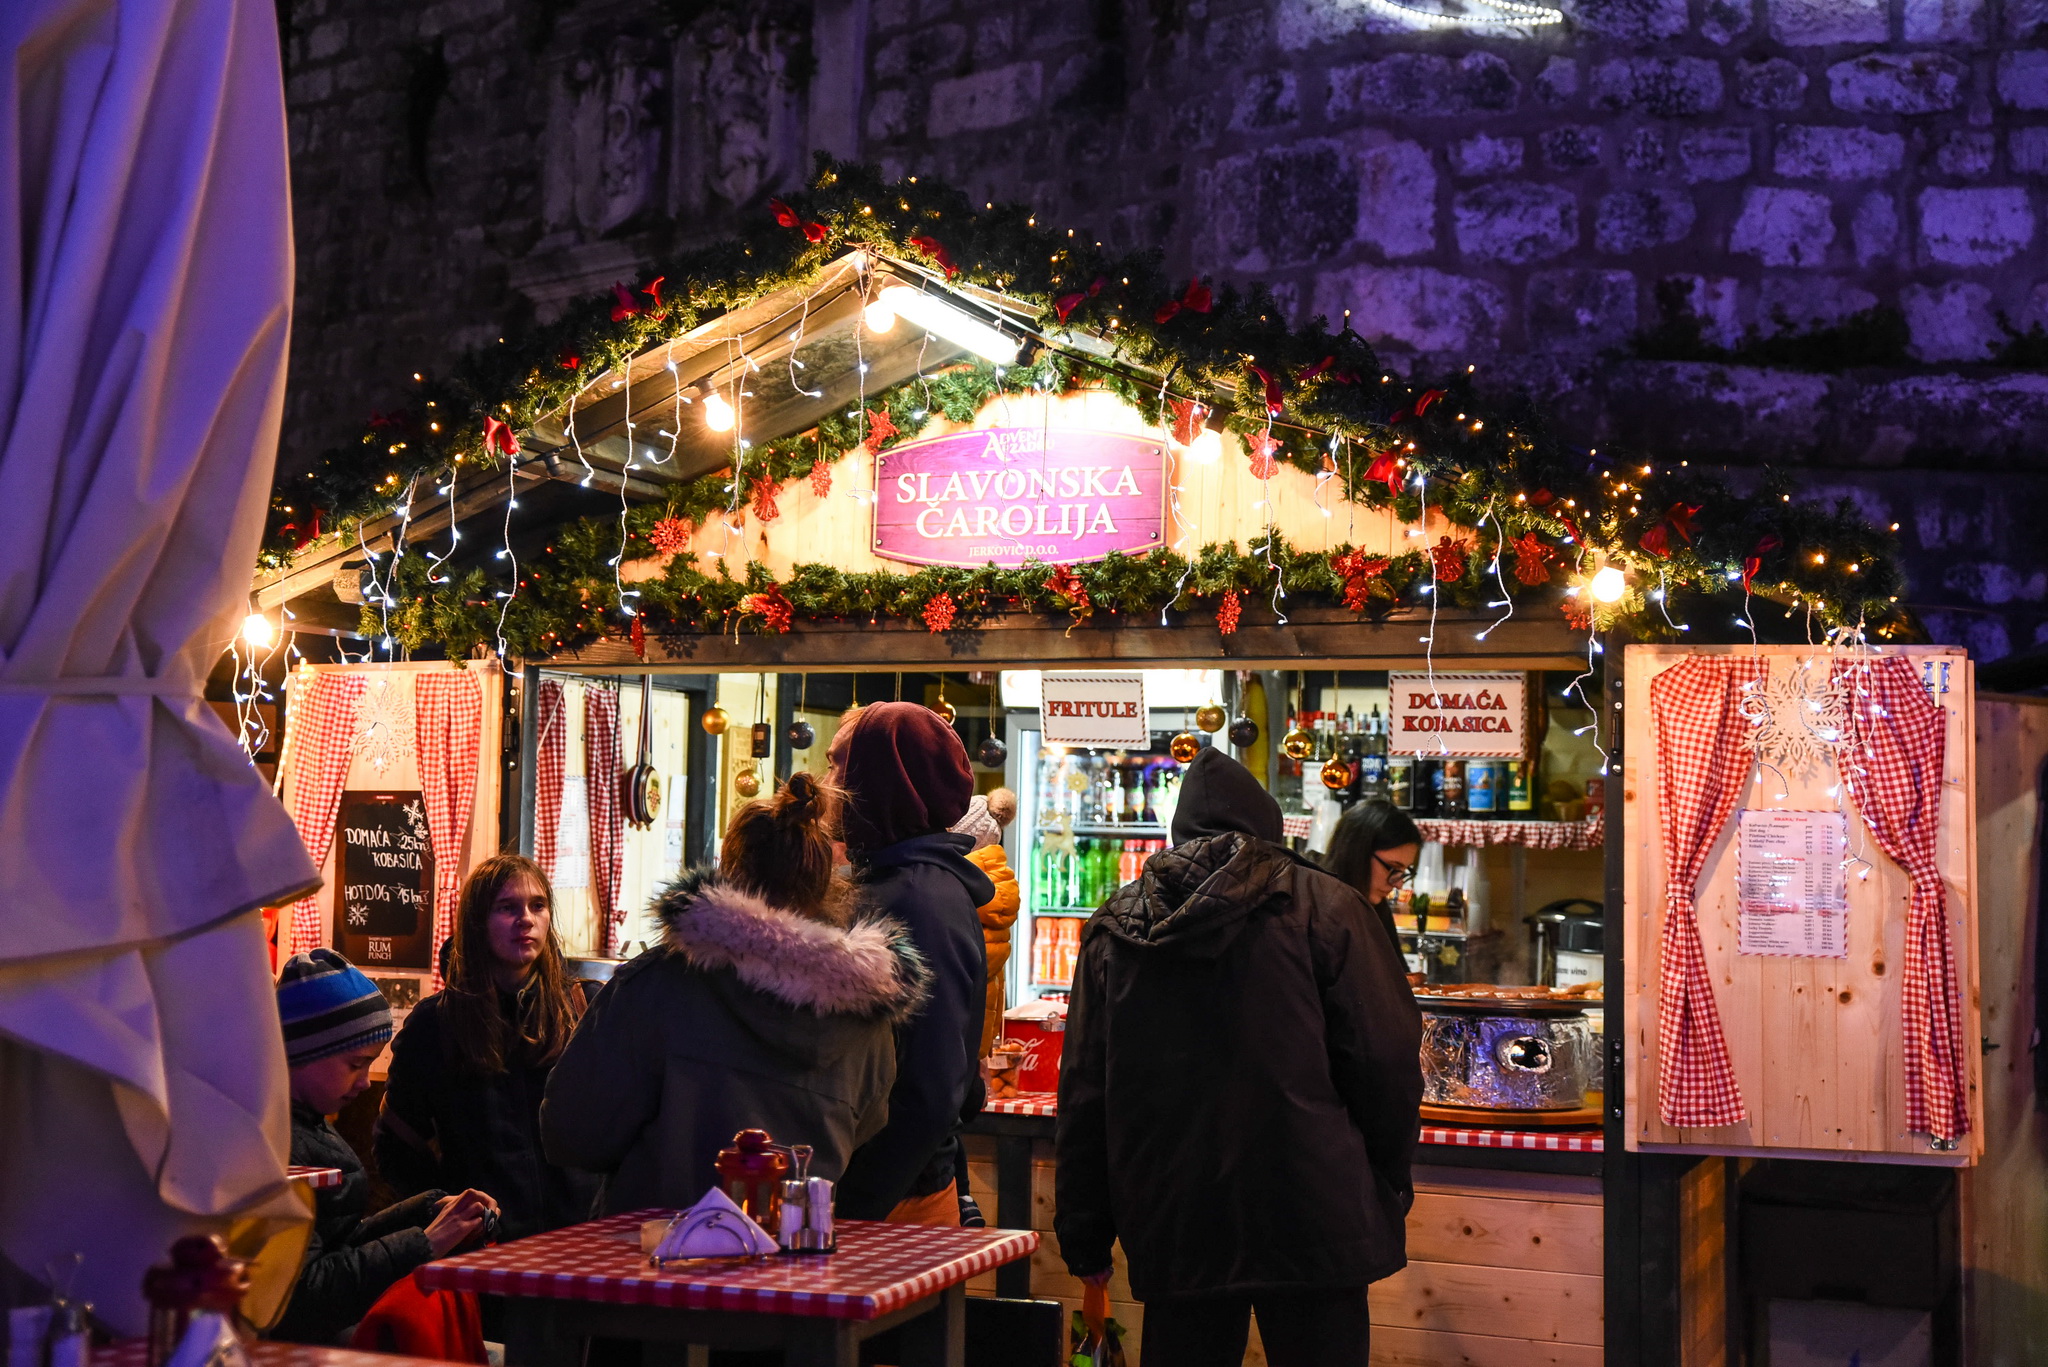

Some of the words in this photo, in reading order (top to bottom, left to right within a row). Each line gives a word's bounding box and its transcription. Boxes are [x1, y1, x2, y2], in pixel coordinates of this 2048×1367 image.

[896, 465, 1142, 503] SLAVONSKA
[916, 501, 1118, 541] ČAROLIJA
[1025, 544, 1060, 556] D.O.O.
[1408, 689, 1508, 710] DOMAĆA
[1047, 701, 1138, 718] FRITULE
[1402, 715, 1513, 733] KOBASICA
[344, 824, 392, 848] DOMAĆA
[371, 852, 423, 870] KOBASICA
[368, 941, 391, 953] RUM
[368, 952, 392, 960] PUNCH
